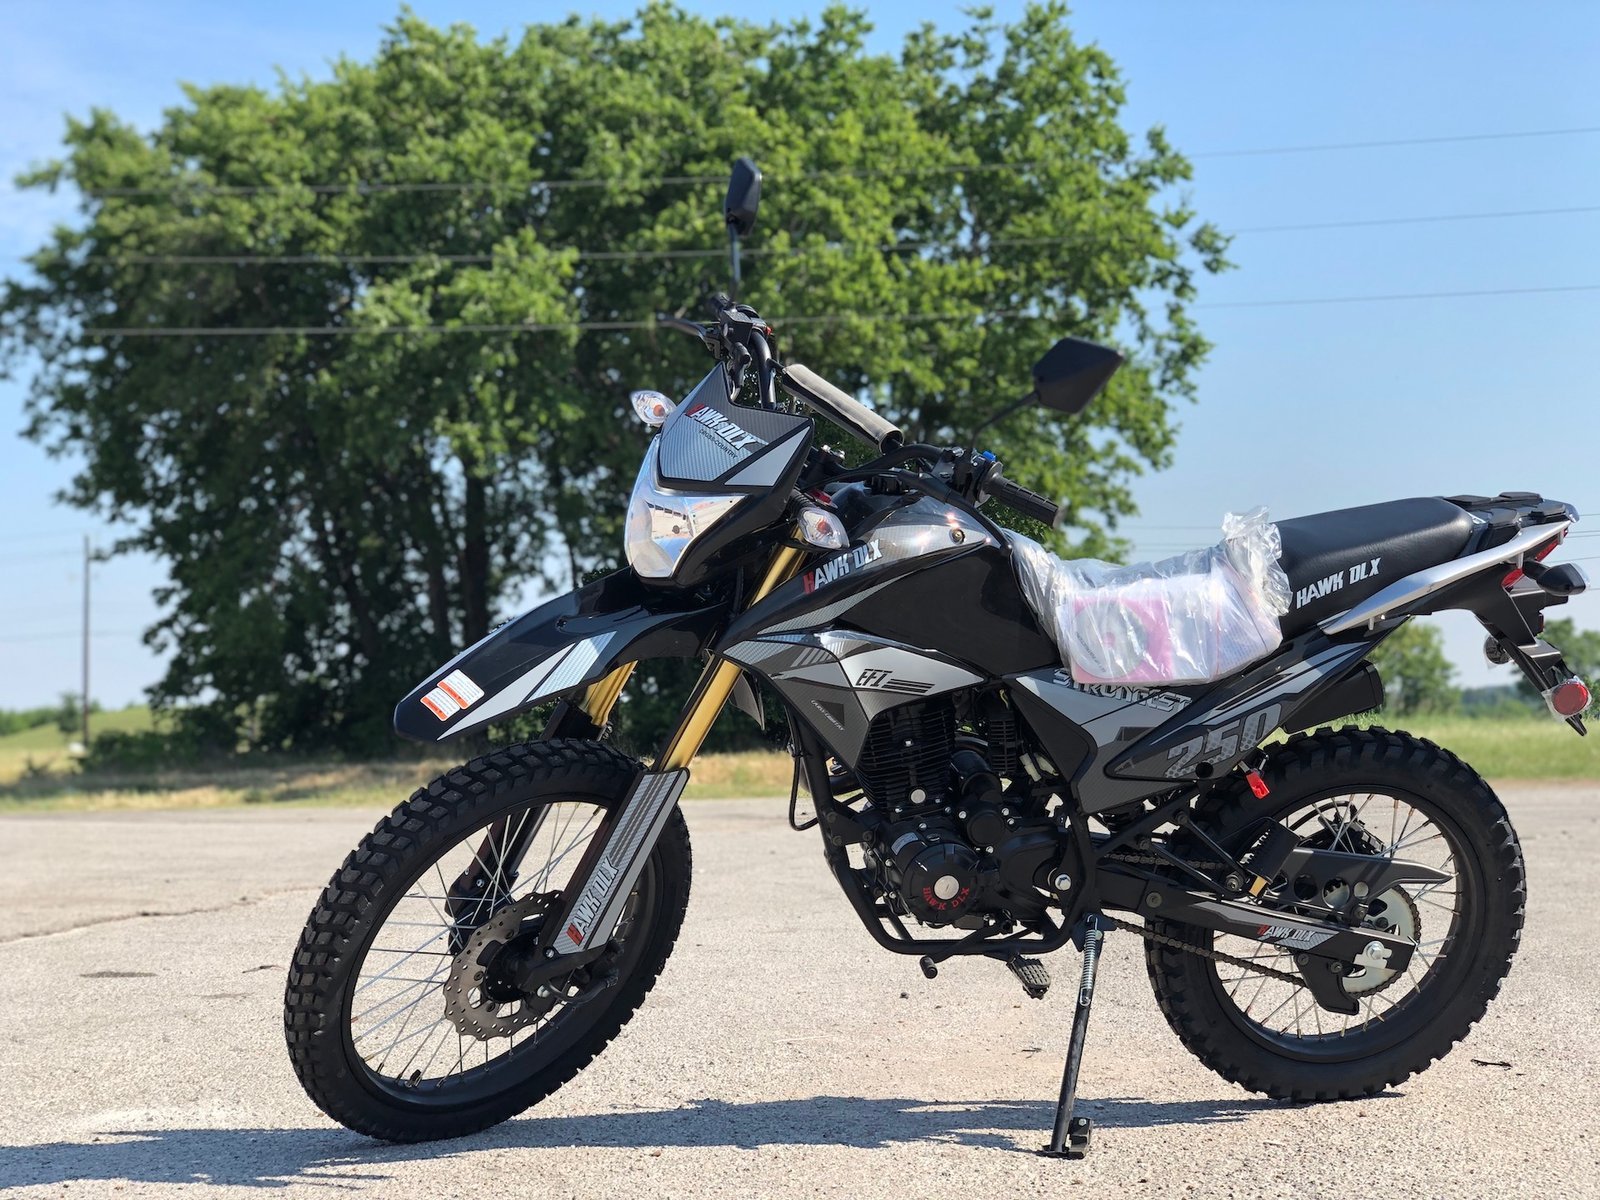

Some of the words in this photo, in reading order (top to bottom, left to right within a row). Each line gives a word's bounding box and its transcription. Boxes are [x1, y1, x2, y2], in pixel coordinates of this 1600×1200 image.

[684, 403, 729, 429] HAWK
[715, 422, 757, 451] DLX
[803, 552, 850, 595] HAWK
[853, 538, 882, 569] DLX
[1296, 570, 1344, 609] HAWK
[1349, 557, 1381, 585] DLX
[855, 668, 893, 687] EFI
[1163, 702, 1282, 778] 250
[566, 889, 601, 946] HAWK
[593, 856, 619, 898] DLX
[1257, 924, 1293, 939] HAWK
[1292, 929, 1316, 941] DLX
